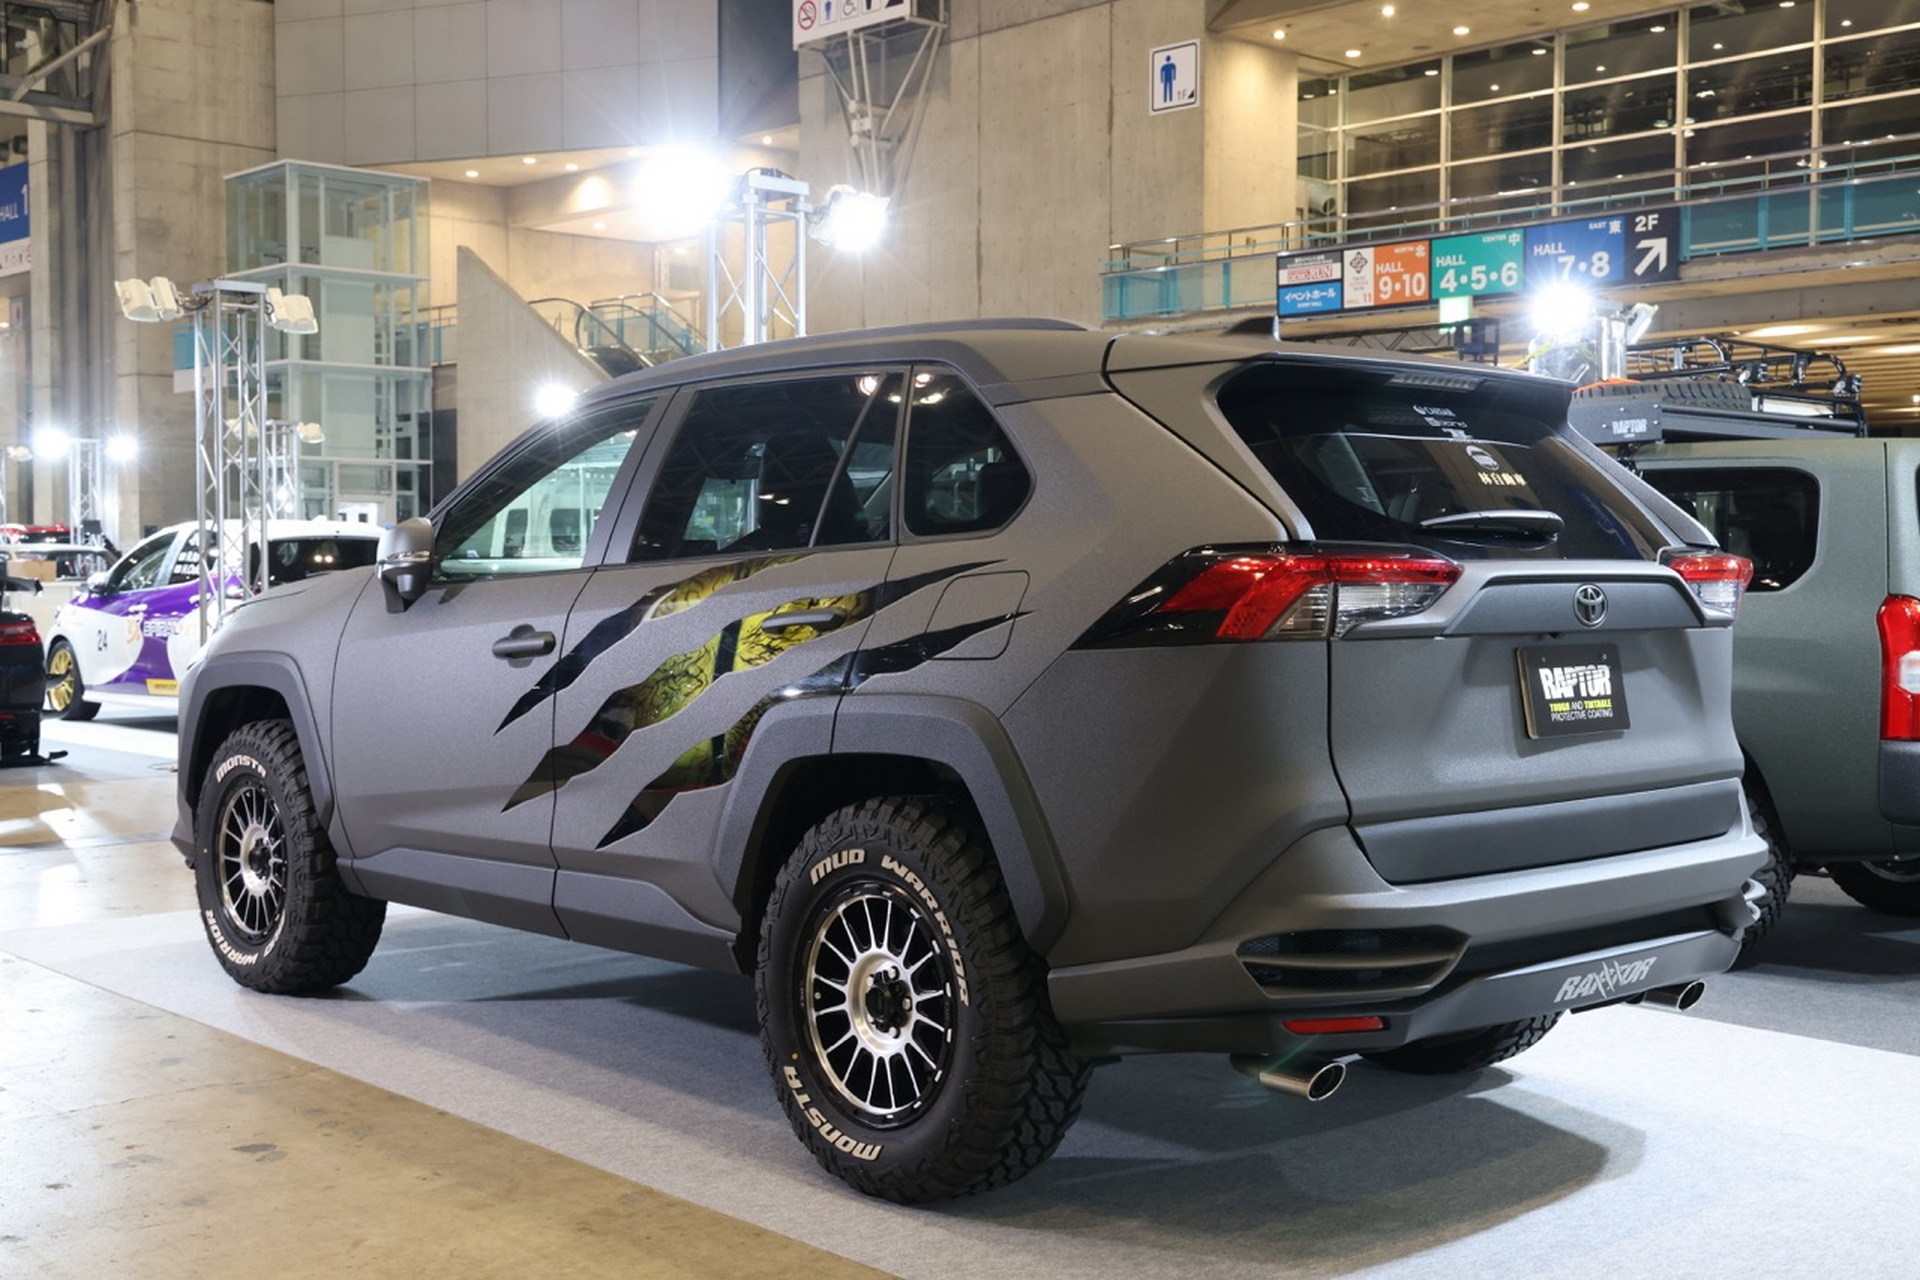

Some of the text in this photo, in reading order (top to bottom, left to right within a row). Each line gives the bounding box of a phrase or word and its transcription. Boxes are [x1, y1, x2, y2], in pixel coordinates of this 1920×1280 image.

[21, 183, 29, 216] 1
[1589, 219, 1622, 234] EAST 東
[1634, 214, 1659, 232] 2F
[1508, 232, 1520, 246] 中
[1533, 242, 1566, 256] HALL
[1376, 262, 1404, 274] HALL
[1436, 254, 1466, 267] HALL
[1284, 288, 1337, 302] イベントホール
[1612, 419, 1647, 435] RAPTOR
[97, 629, 109, 652] 24
[1539, 665, 1612, 700] RAPTOR
[1571, 701, 1584, 710] AND
[1551, 709, 1613, 722] PROTECTIVE COATING
[216, 754, 266, 783] MONSTA
[809, 849, 970, 1007] MUD WARRIOR
[784, 1065, 884, 1161] MONSTA
